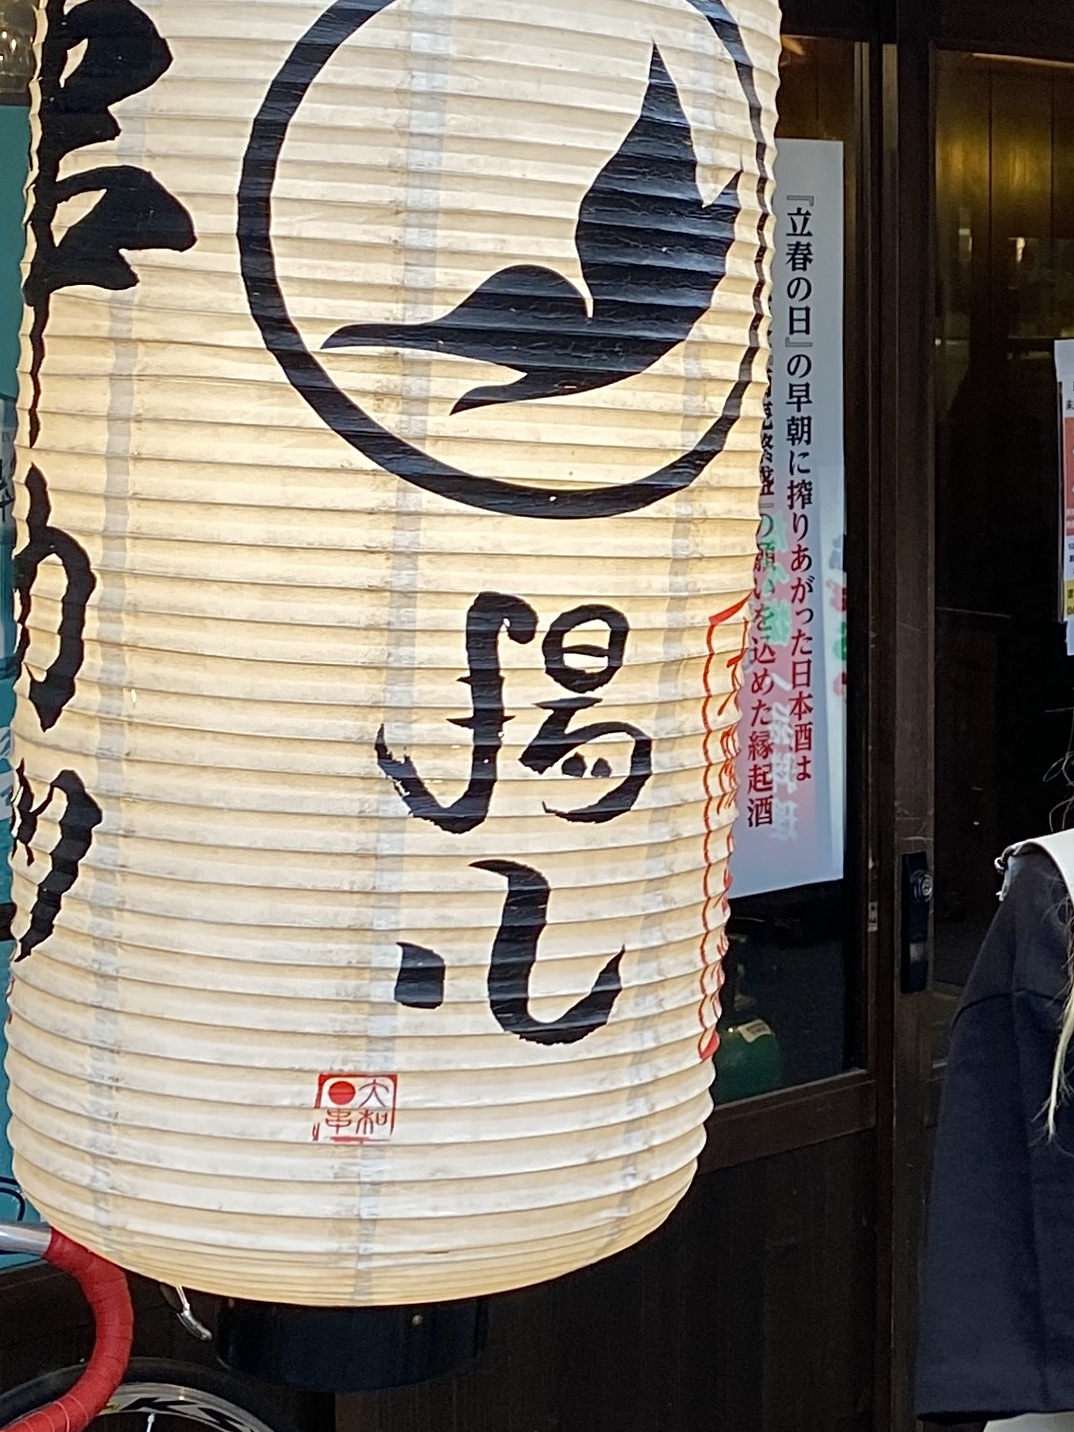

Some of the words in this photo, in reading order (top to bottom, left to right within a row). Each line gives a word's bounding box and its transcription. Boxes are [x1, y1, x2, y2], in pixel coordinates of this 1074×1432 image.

[784, 194, 814, 783] 『立春の日』の早朝に搾りあがった日本酒は
